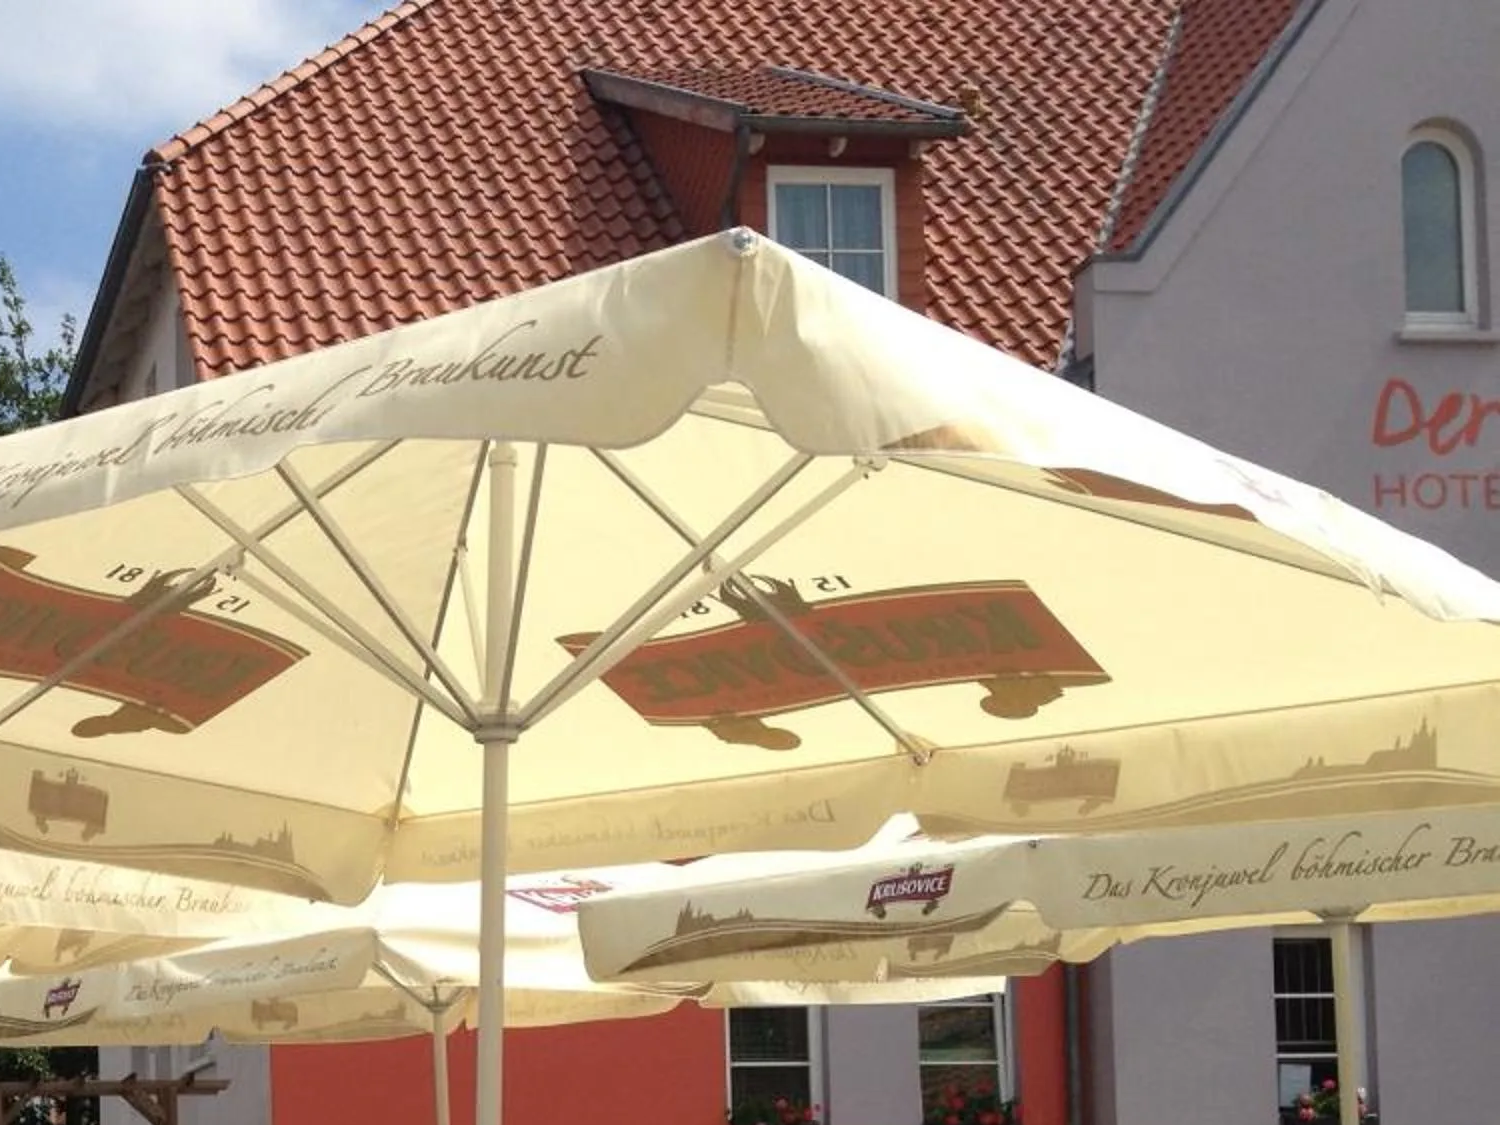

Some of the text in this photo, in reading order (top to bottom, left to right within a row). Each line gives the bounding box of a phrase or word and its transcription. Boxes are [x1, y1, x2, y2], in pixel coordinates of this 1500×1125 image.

[355, 319, 604, 398] Braukunst
[1080, 872, 1132, 900] Das
[1140, 841, 1290, 908] Kronjuwel
[1290, 822, 1432, 882] böhmischer
